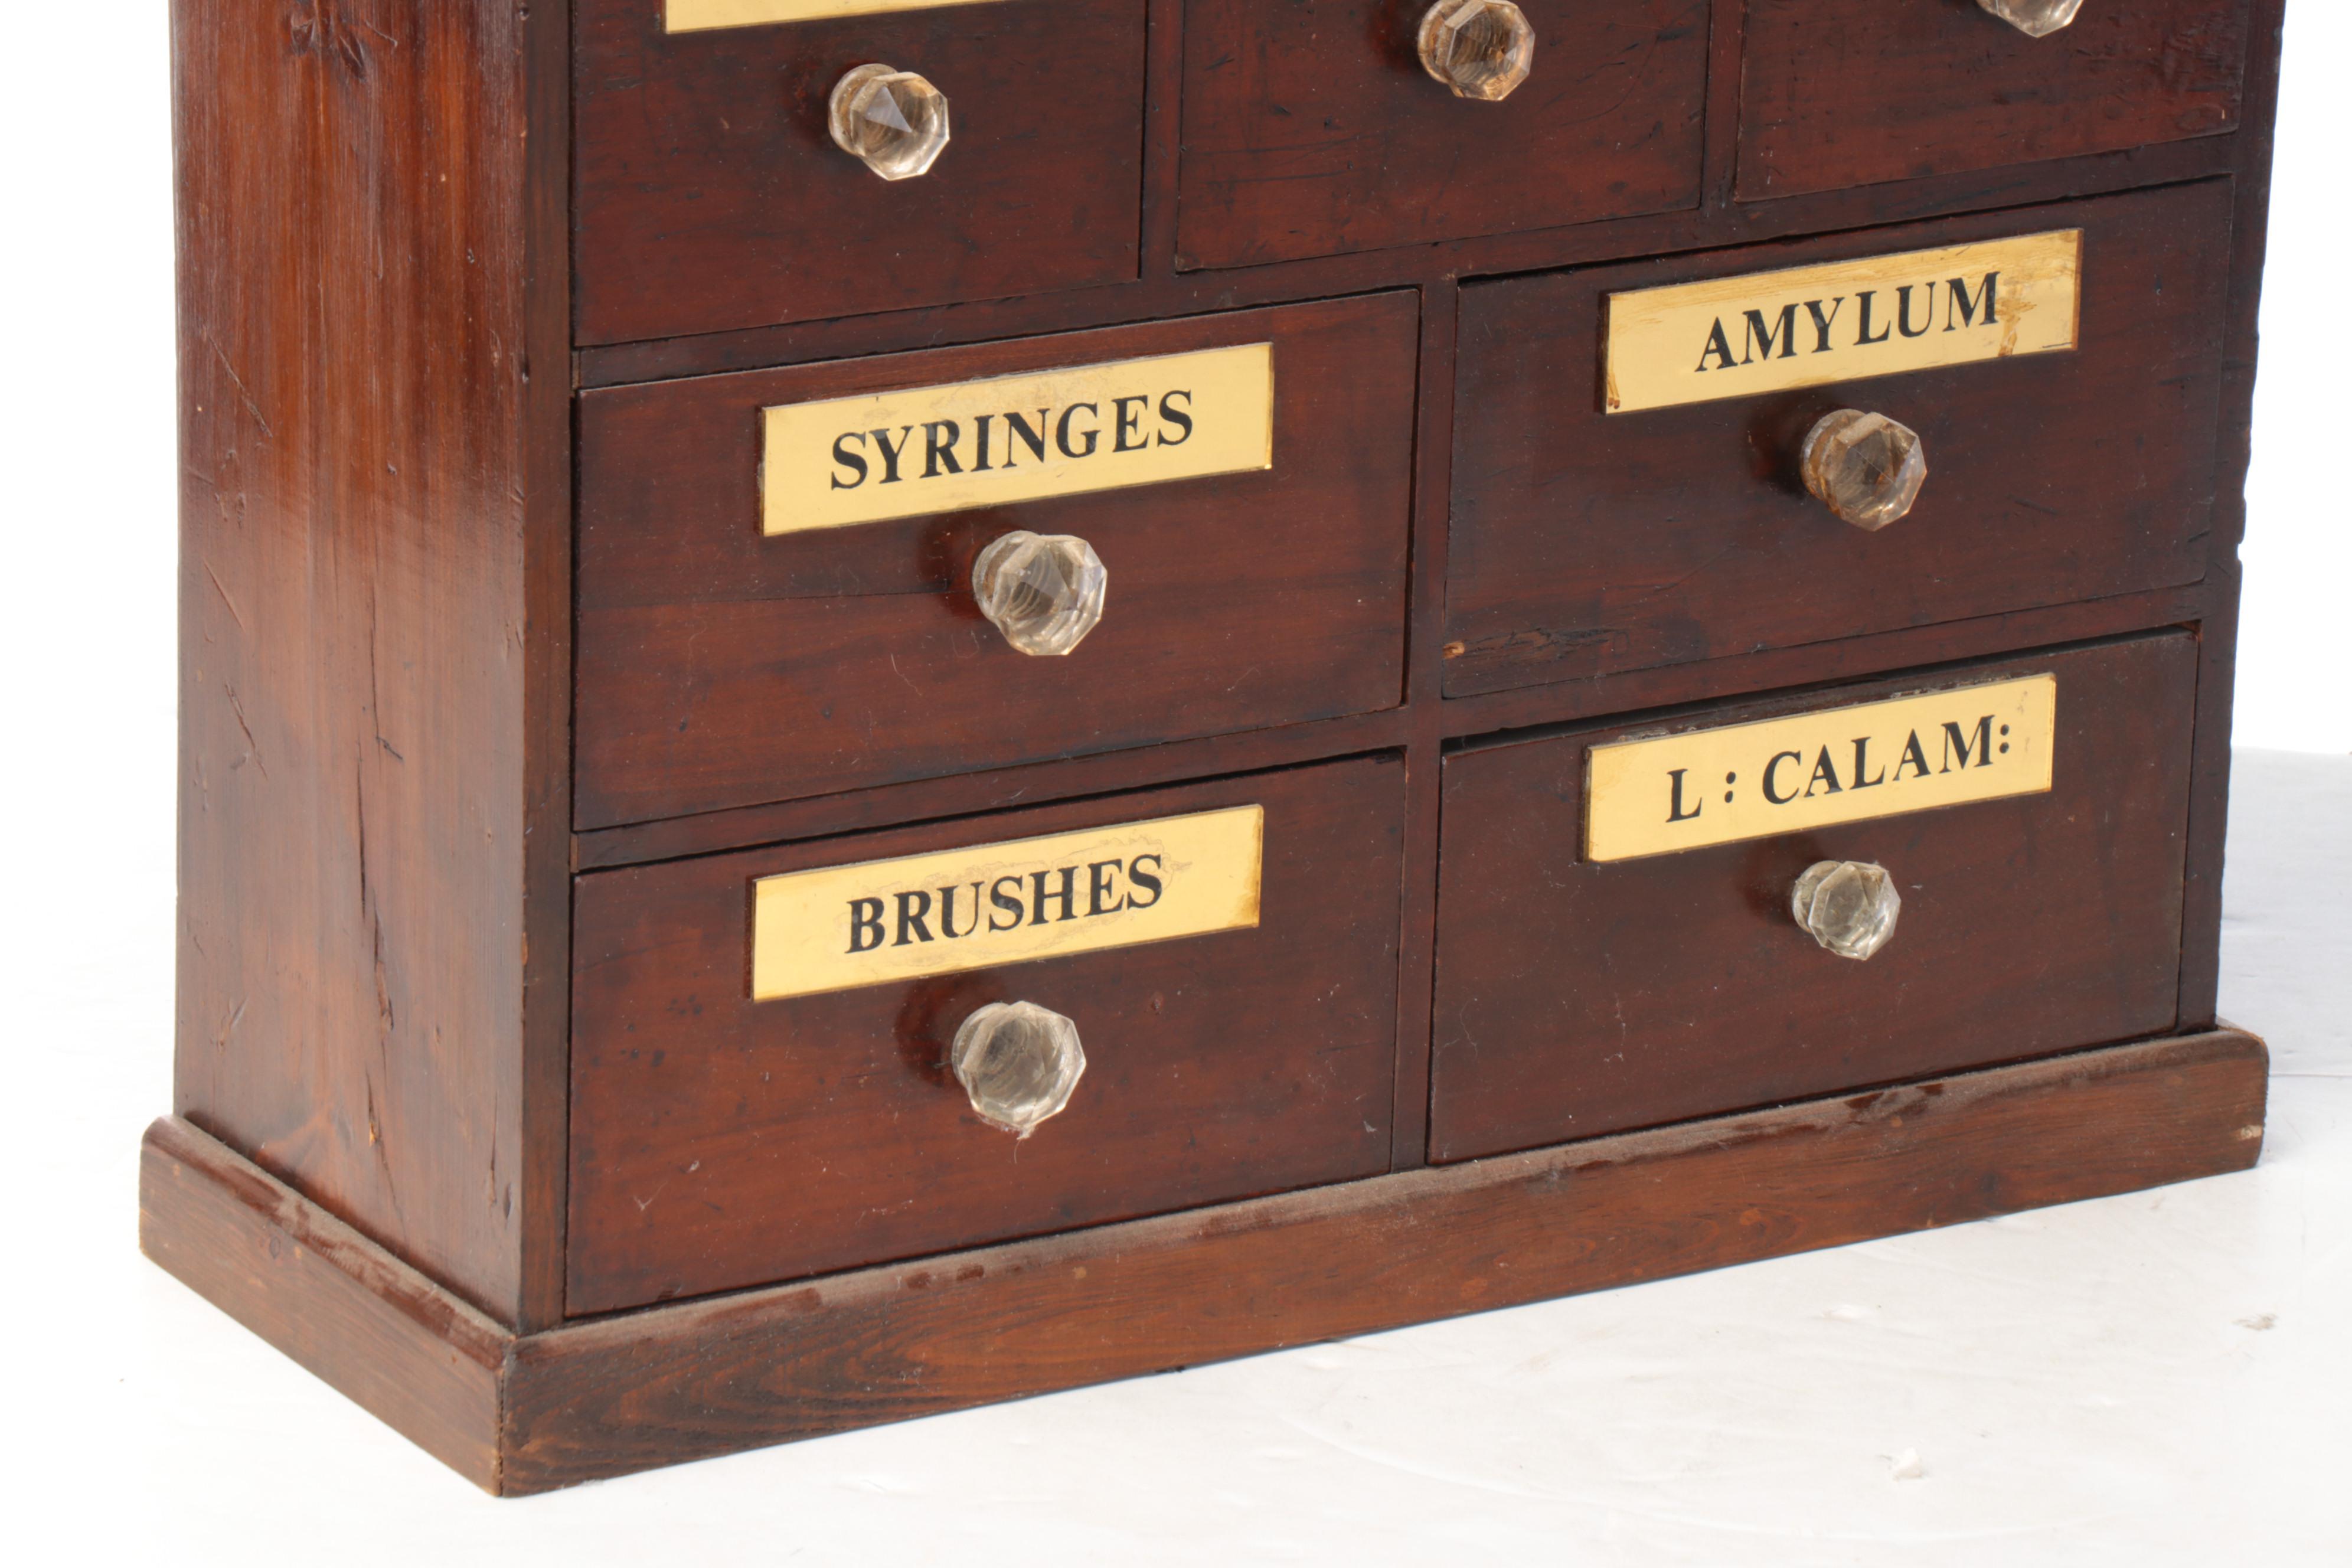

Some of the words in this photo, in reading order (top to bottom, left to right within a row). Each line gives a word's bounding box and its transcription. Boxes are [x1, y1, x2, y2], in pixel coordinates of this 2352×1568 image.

[1695, 272, 2001, 373] AMYLUM
[831, 390, 1193, 491] SYRINGES
[1762, 715, 2010, 805] CALAM:
[844, 854, 1162, 955] BRUSHES
